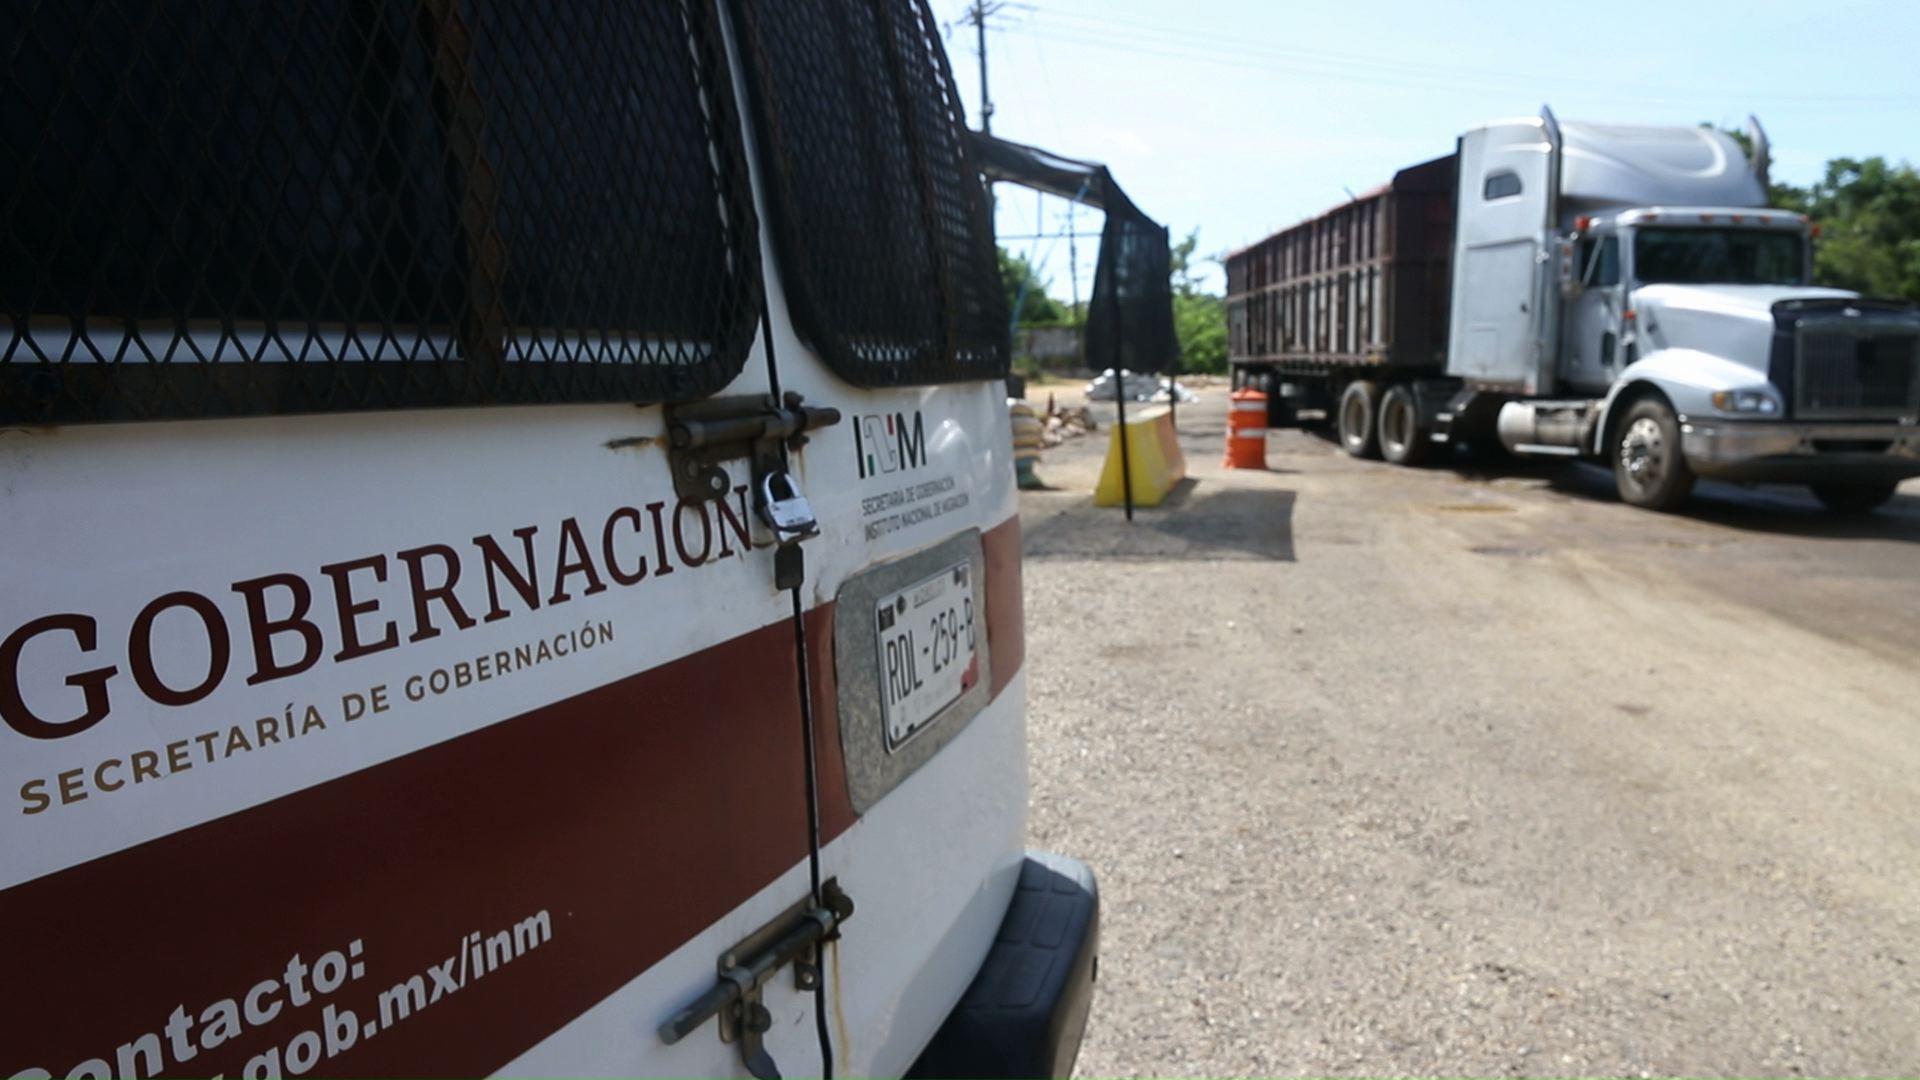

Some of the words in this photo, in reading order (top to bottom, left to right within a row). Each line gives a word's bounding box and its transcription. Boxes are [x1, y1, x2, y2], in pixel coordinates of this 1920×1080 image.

[20, 702, 327, 815] SECRETARÍA
[342, 685, 391, 722] DE
[404, 620, 614, 702] GOBERNACIÓN
